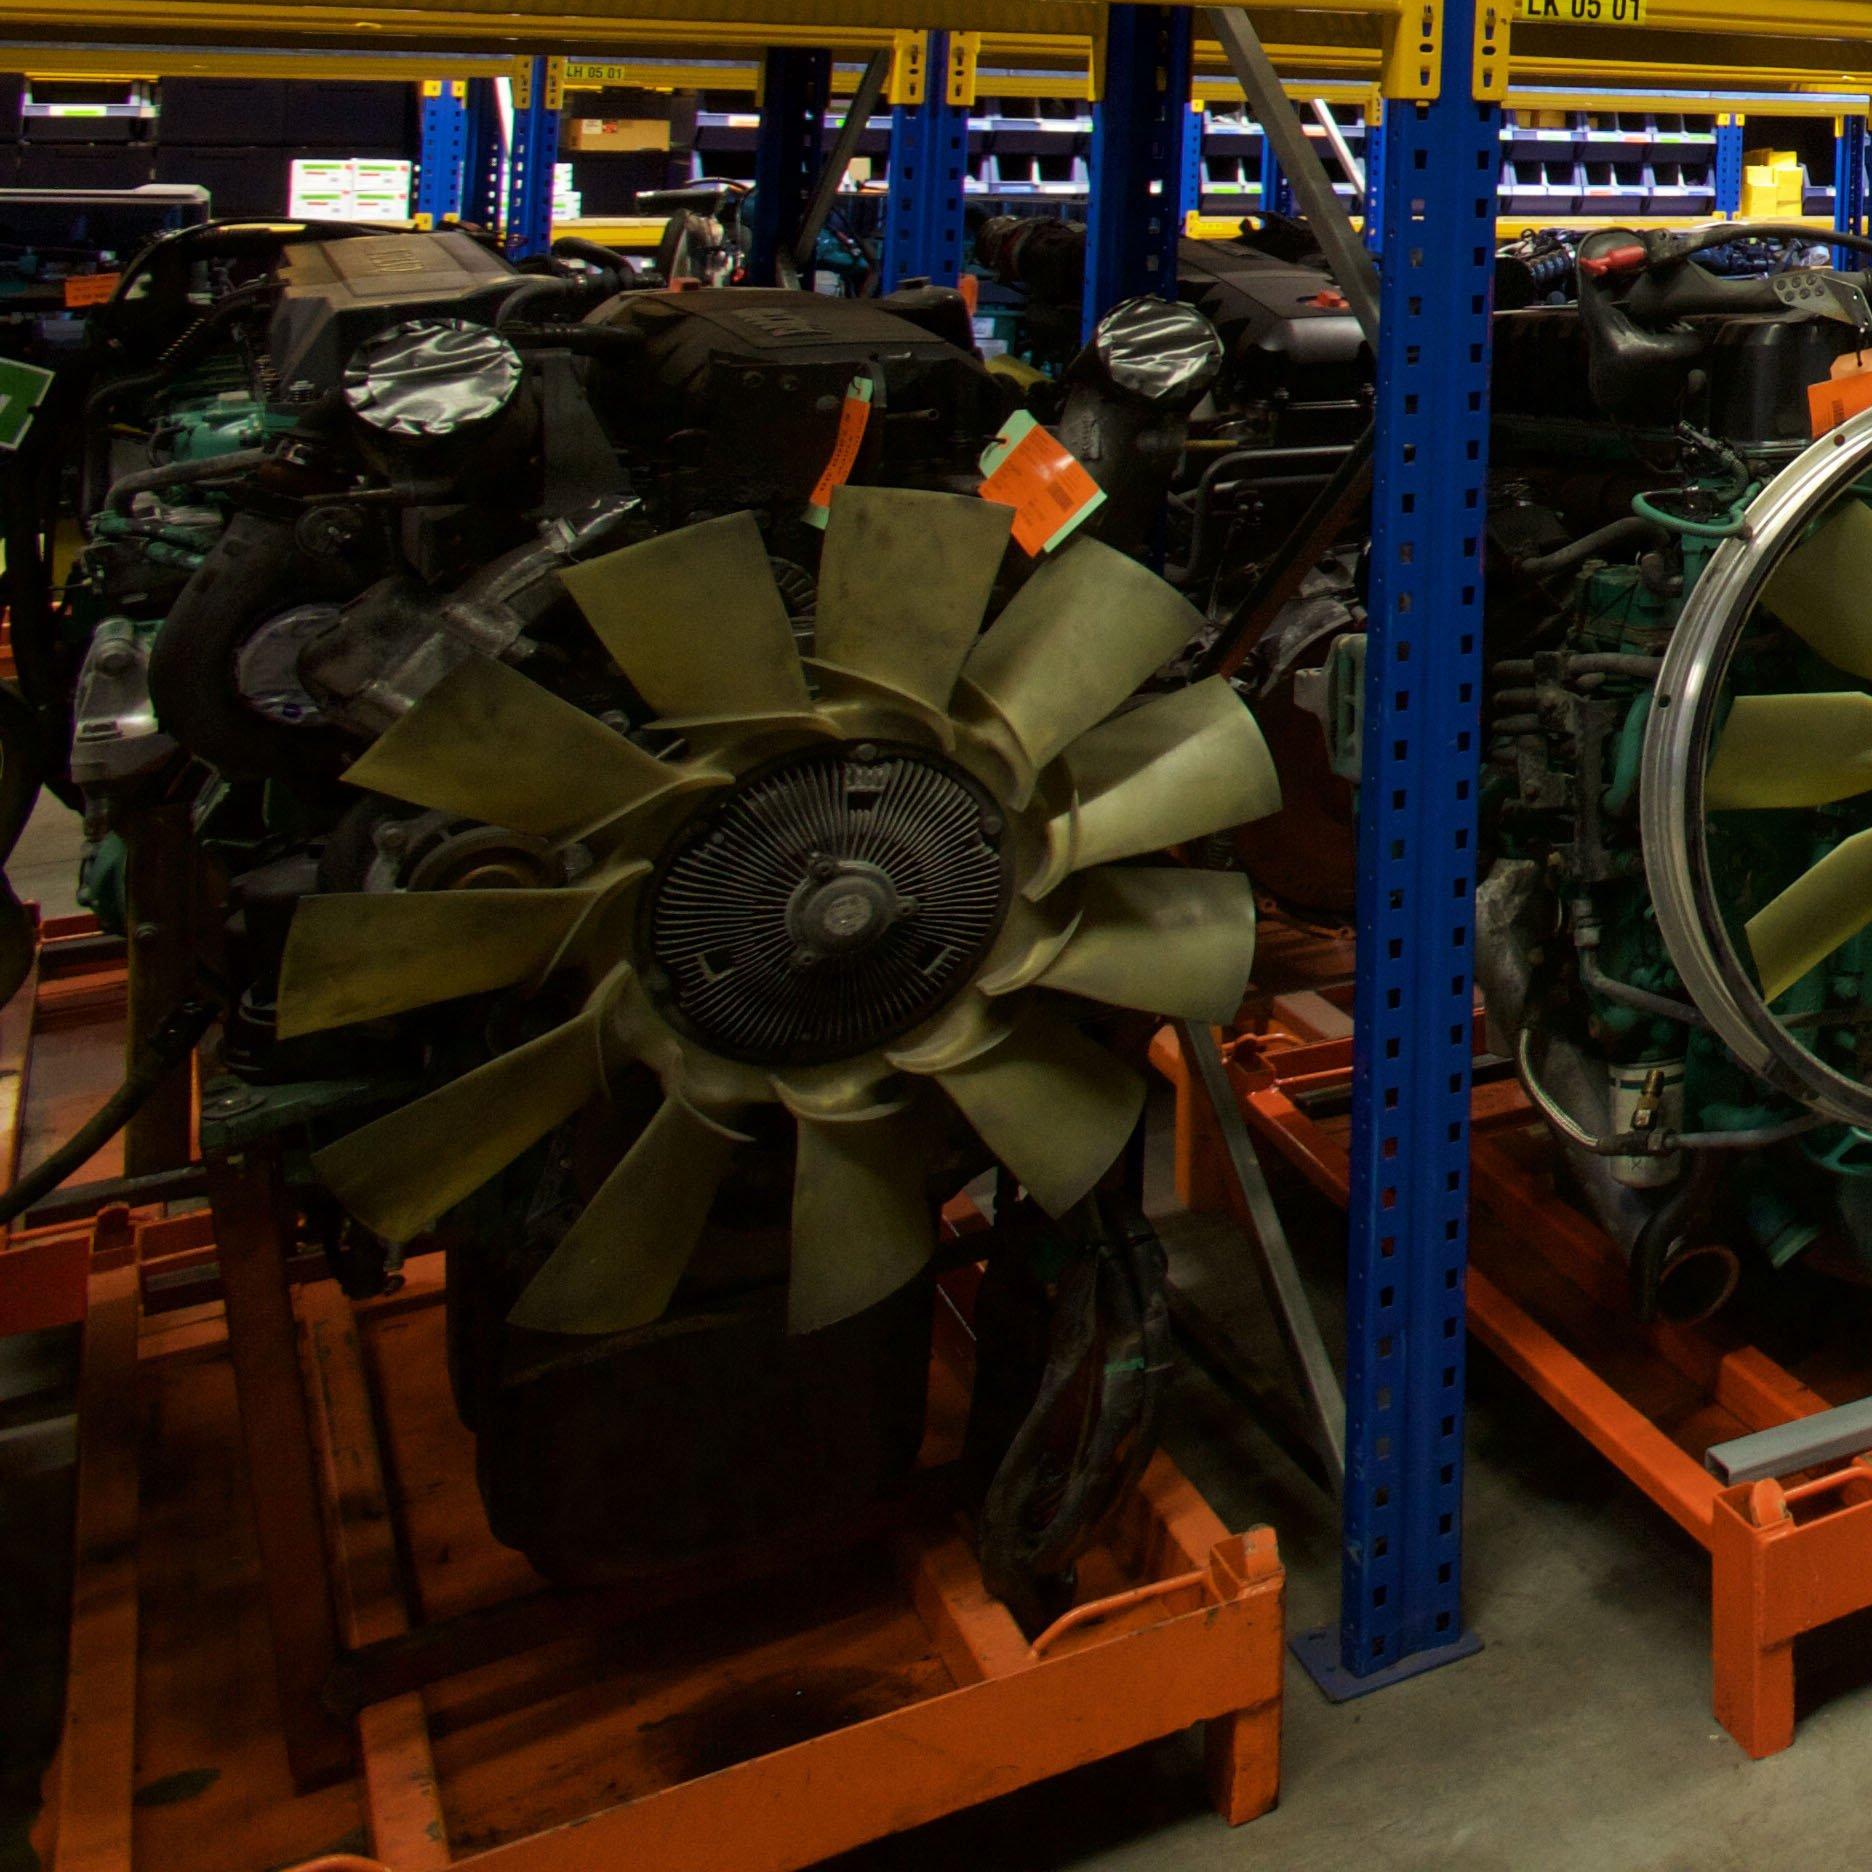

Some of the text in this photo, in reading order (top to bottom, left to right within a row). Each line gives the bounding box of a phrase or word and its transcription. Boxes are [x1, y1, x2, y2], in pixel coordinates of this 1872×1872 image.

[566, 65, 622, 80] LH 05 01
